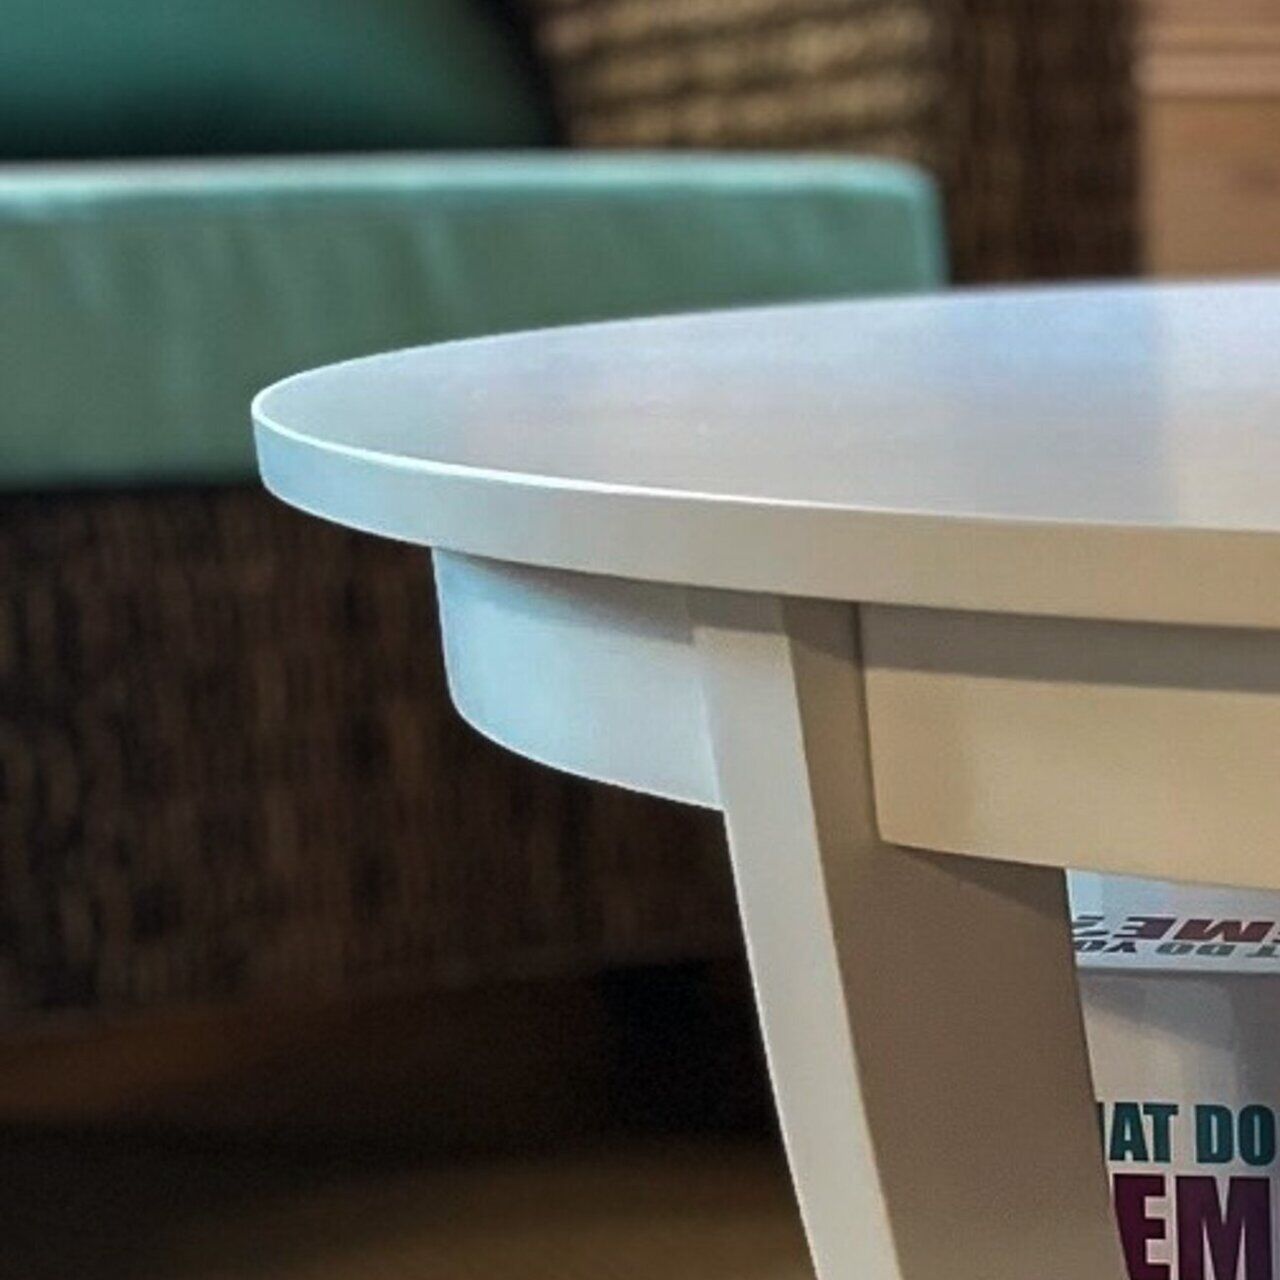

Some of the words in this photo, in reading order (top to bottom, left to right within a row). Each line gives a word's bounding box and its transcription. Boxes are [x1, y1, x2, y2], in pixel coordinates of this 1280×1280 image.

[1073, 938, 1137, 953] YO
[1154, 942, 1237, 958] DO
[1096, 1102, 1178, 1163] AT
[1195, 1104, 1276, 1166] DO
